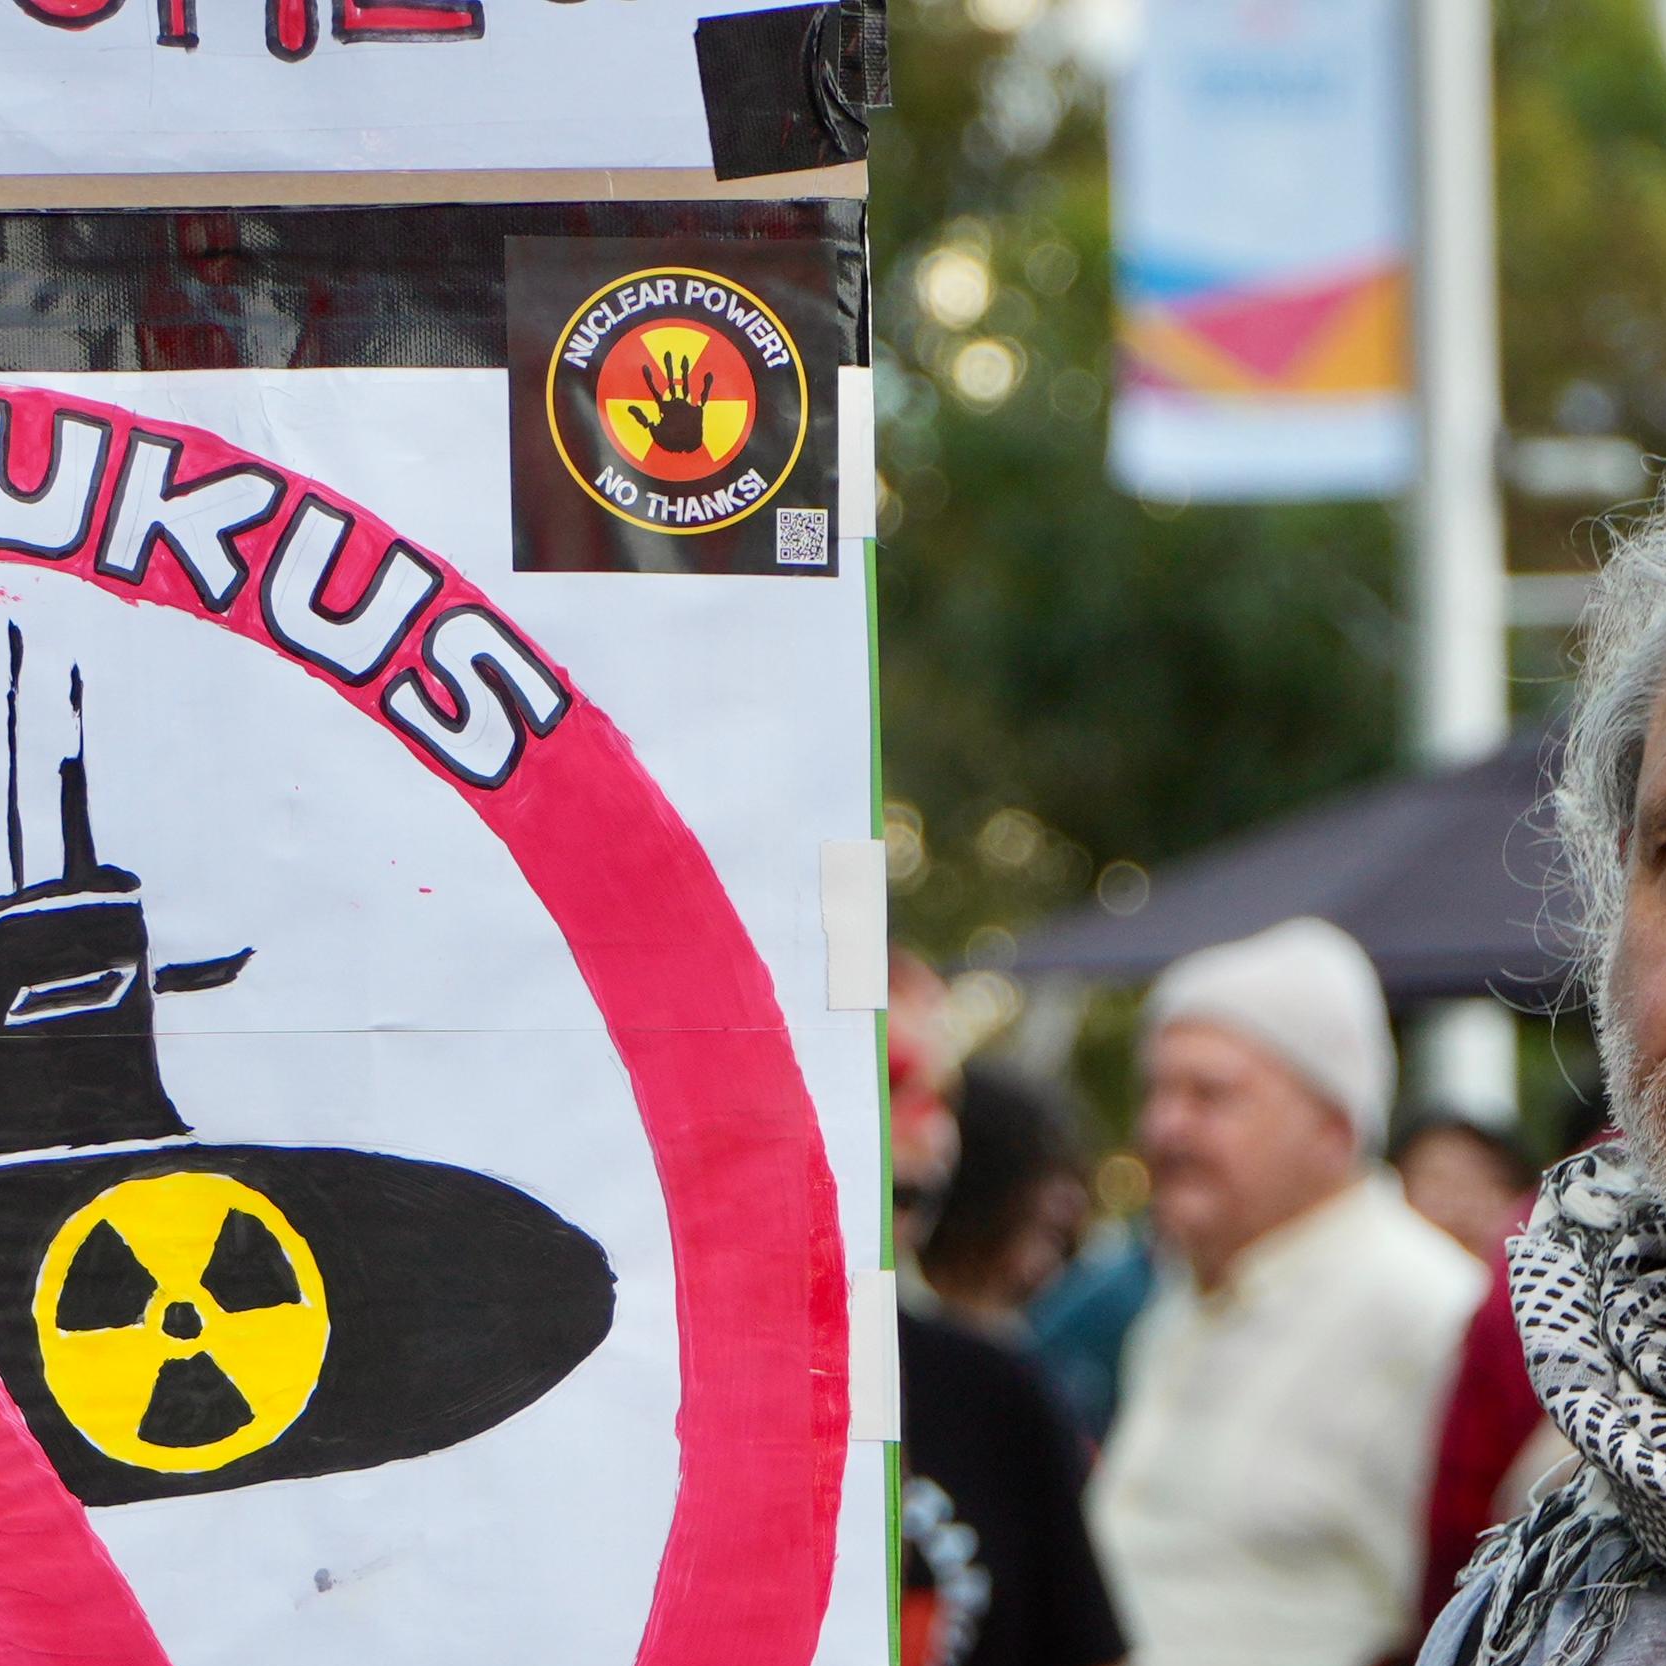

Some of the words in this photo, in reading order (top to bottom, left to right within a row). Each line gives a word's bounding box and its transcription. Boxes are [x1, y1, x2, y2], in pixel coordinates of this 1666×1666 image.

[563, 279, 677, 369] NUCLEAR
[684, 279, 790, 369] POWER?
[594, 465, 638, 506] NO
[646, 467, 768, 522] THANKS!
